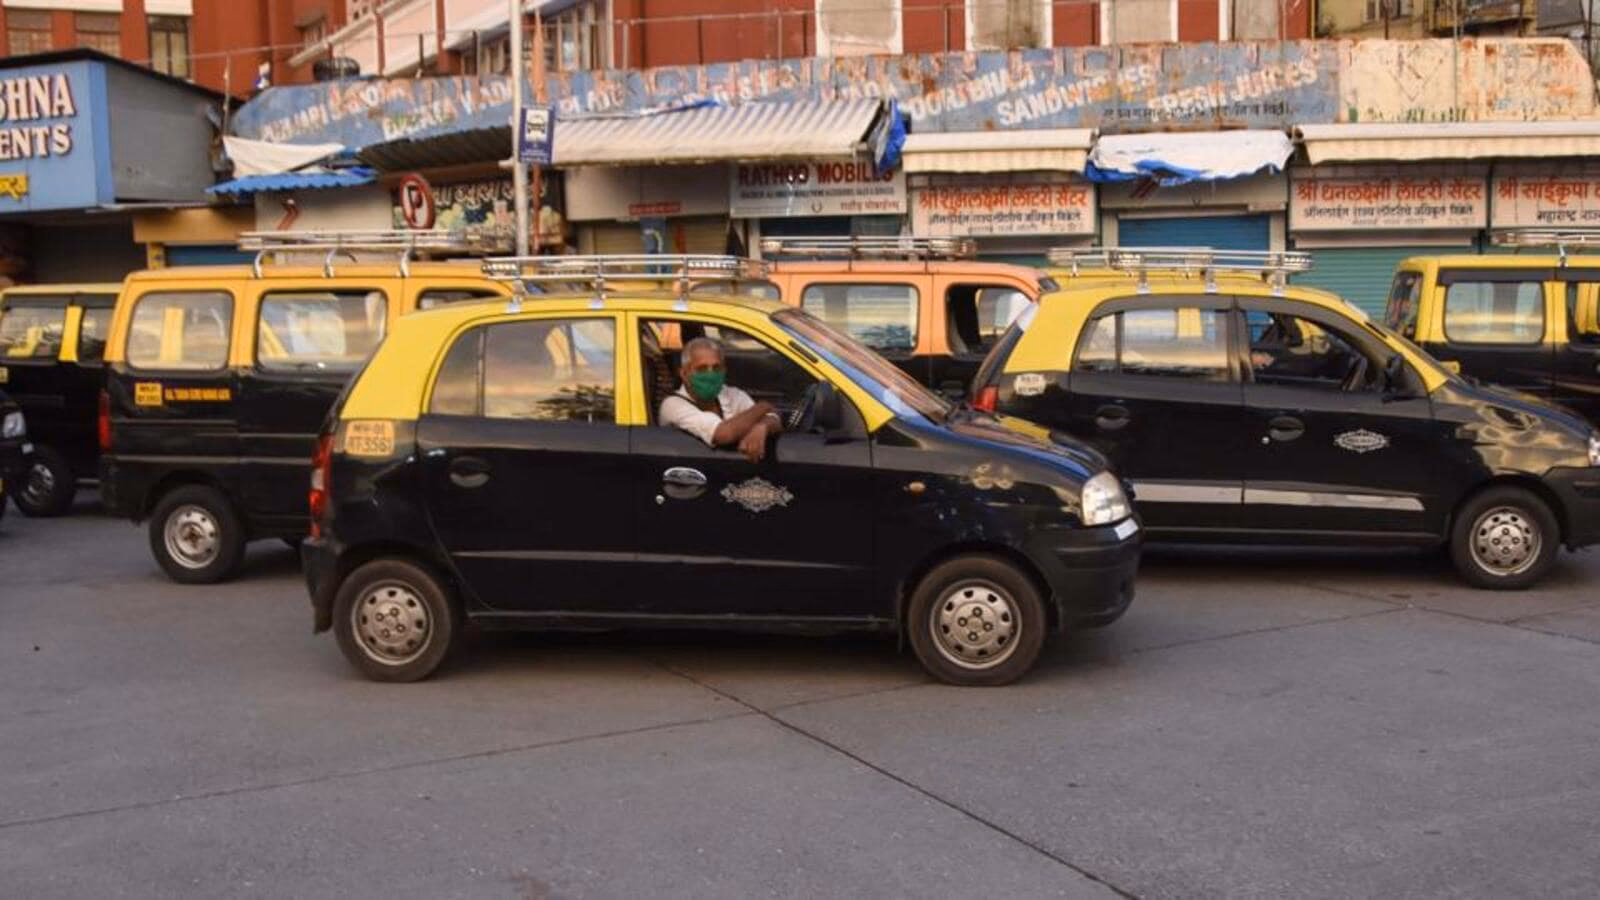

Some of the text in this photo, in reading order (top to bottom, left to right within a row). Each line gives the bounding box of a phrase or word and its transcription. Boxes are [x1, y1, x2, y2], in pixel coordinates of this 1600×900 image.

[1230, 58, 1318, 101] JUICES
[0, 125, 72, 160] ENTS
[919, 185, 937, 209] श्री
[1012, 184, 1053, 208] लॉटरी
[1296, 179, 1317, 201] श्री
[1396, 178, 1442, 200] लॉटरी
[1499, 176, 1518, 198] श्री
